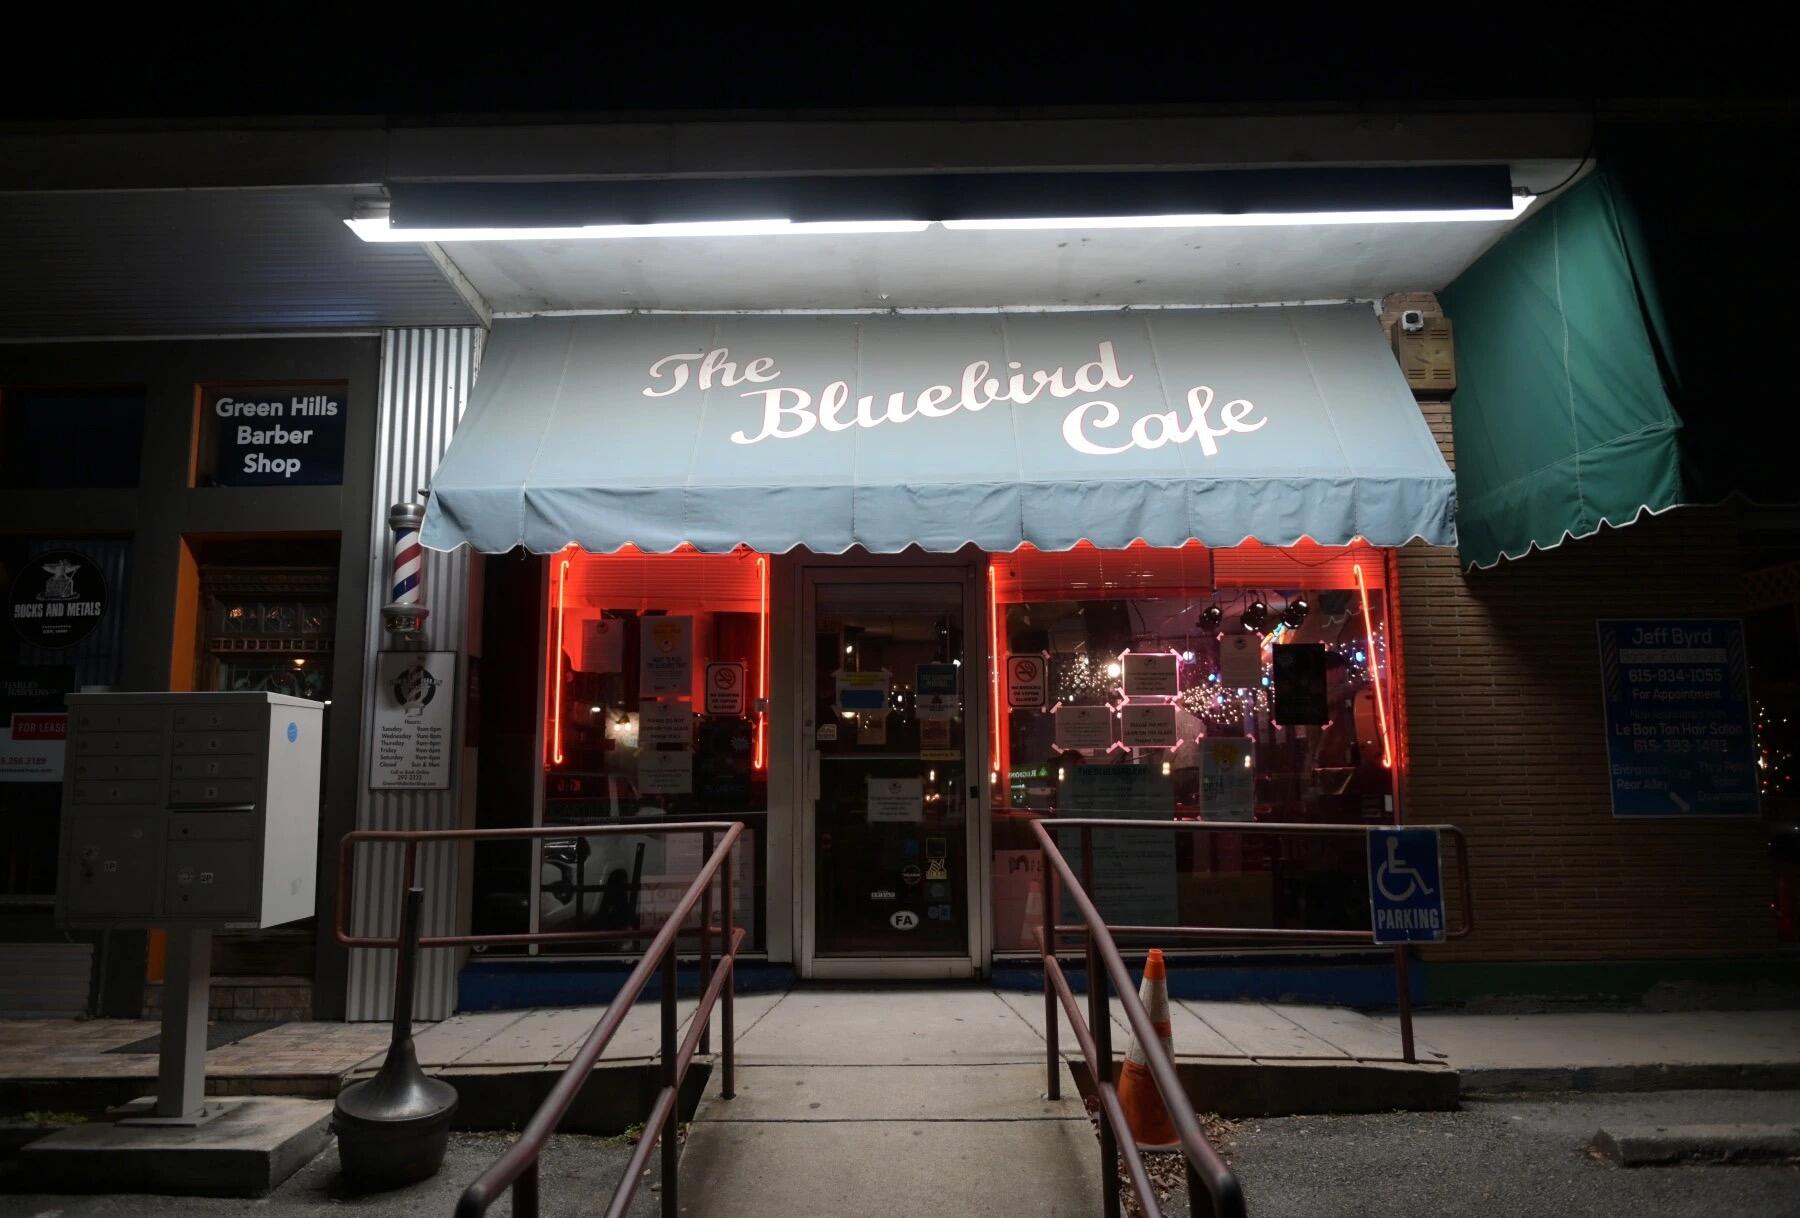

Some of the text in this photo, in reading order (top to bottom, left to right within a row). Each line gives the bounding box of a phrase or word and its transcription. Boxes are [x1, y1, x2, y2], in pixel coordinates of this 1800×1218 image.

[641, 347, 782, 398] The
[729, 340, 1134, 445] Bluebird
[215, 395, 339, 417] Green Hills
[1062, 385, 1269, 457] Cafe
[236, 424, 314, 445] Barber
[242, 452, 302, 478] Shop
[13, 601, 102, 618] ROCKS AND METALS
[1631, 626, 1713, 648] Jeff Byrd
[1632, 688, 1650, 700] For
[17, 722, 66, 734] FOR LEASE
[1615, 721, 1744, 736] Le Bon Ton Hair Salon
[895, 915, 913, 925] FA
[1376, 907, 1440, 929] PARKING
